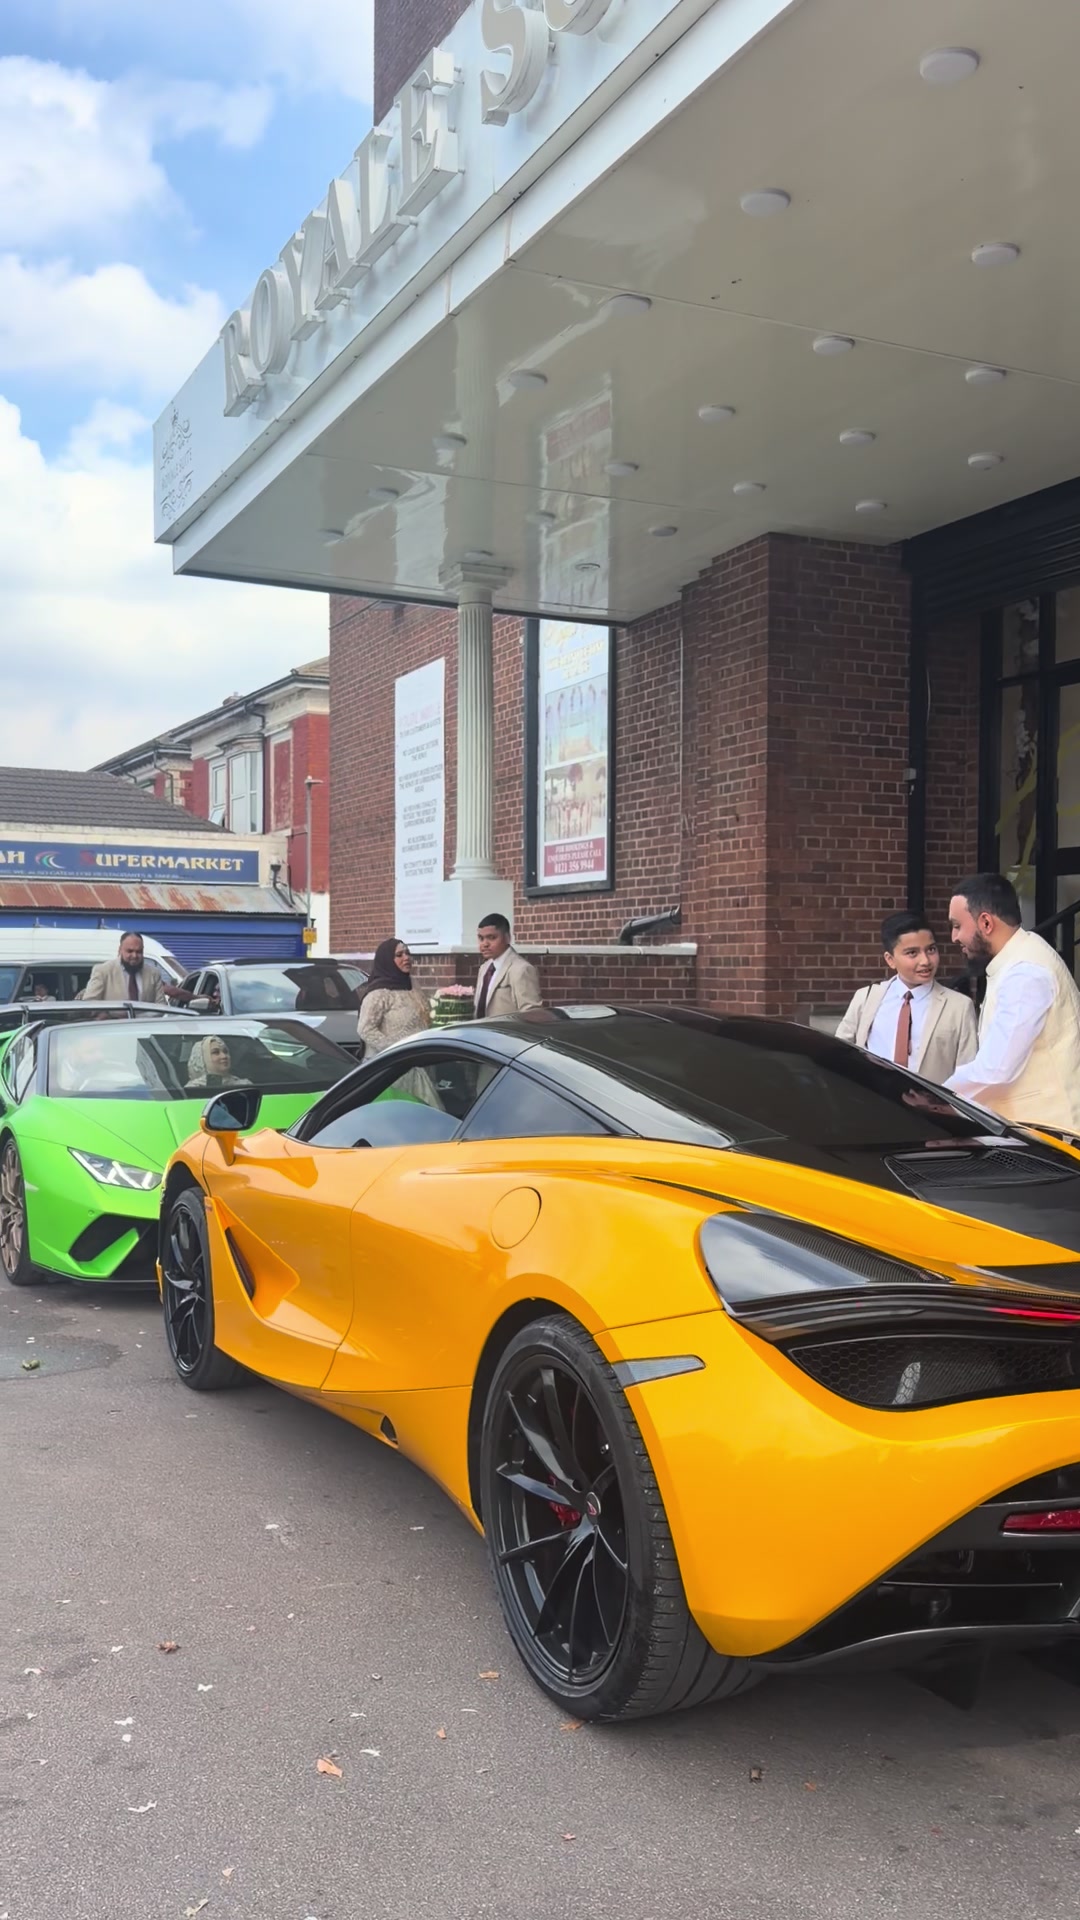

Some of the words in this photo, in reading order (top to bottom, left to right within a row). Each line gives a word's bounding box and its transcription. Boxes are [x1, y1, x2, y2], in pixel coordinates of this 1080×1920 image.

[220, 47, 460, 417] ROYALE
[481, 0, 614, 127] S
[555, 861, 567, 873] 0121
[569, 860, 580, 872] 356
